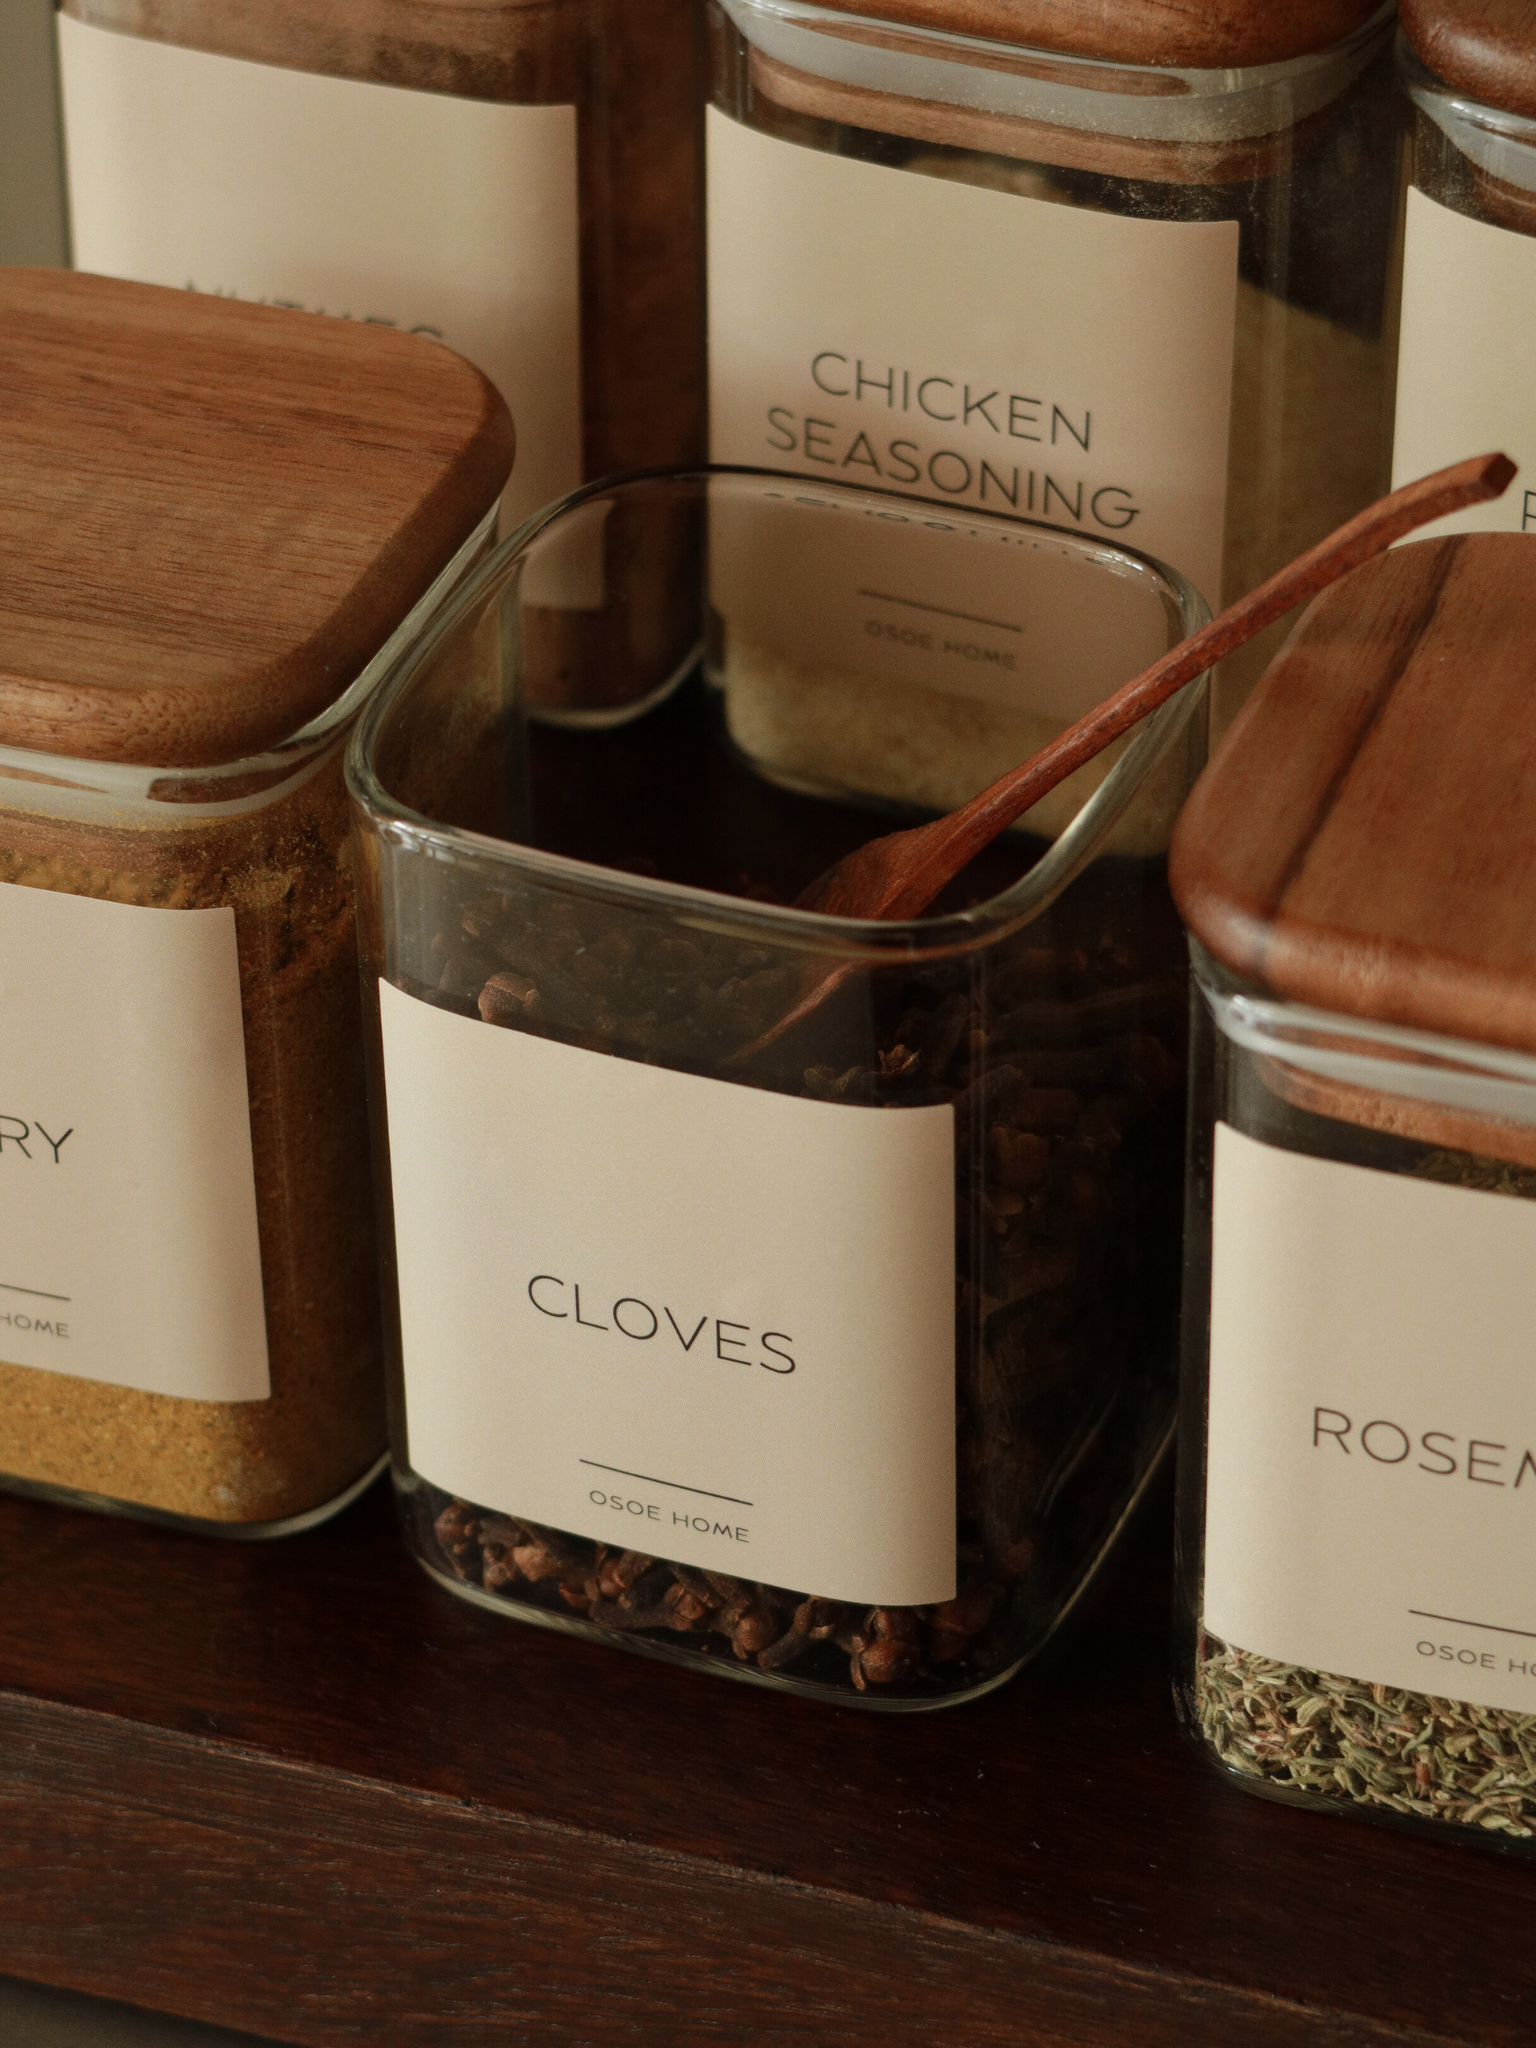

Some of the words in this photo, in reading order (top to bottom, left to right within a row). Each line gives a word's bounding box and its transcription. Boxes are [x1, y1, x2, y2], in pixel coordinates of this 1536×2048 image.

[811, 351, 1091, 452] CHICKEN
[766, 407, 1140, 529] SEASONING
[528, 1274, 796, 1374] CLOVES
[589, 1490, 661, 1521] OSOE
[672, 1511, 750, 1543] HOME
[1416, 1640, 1496, 1670] OSOE
